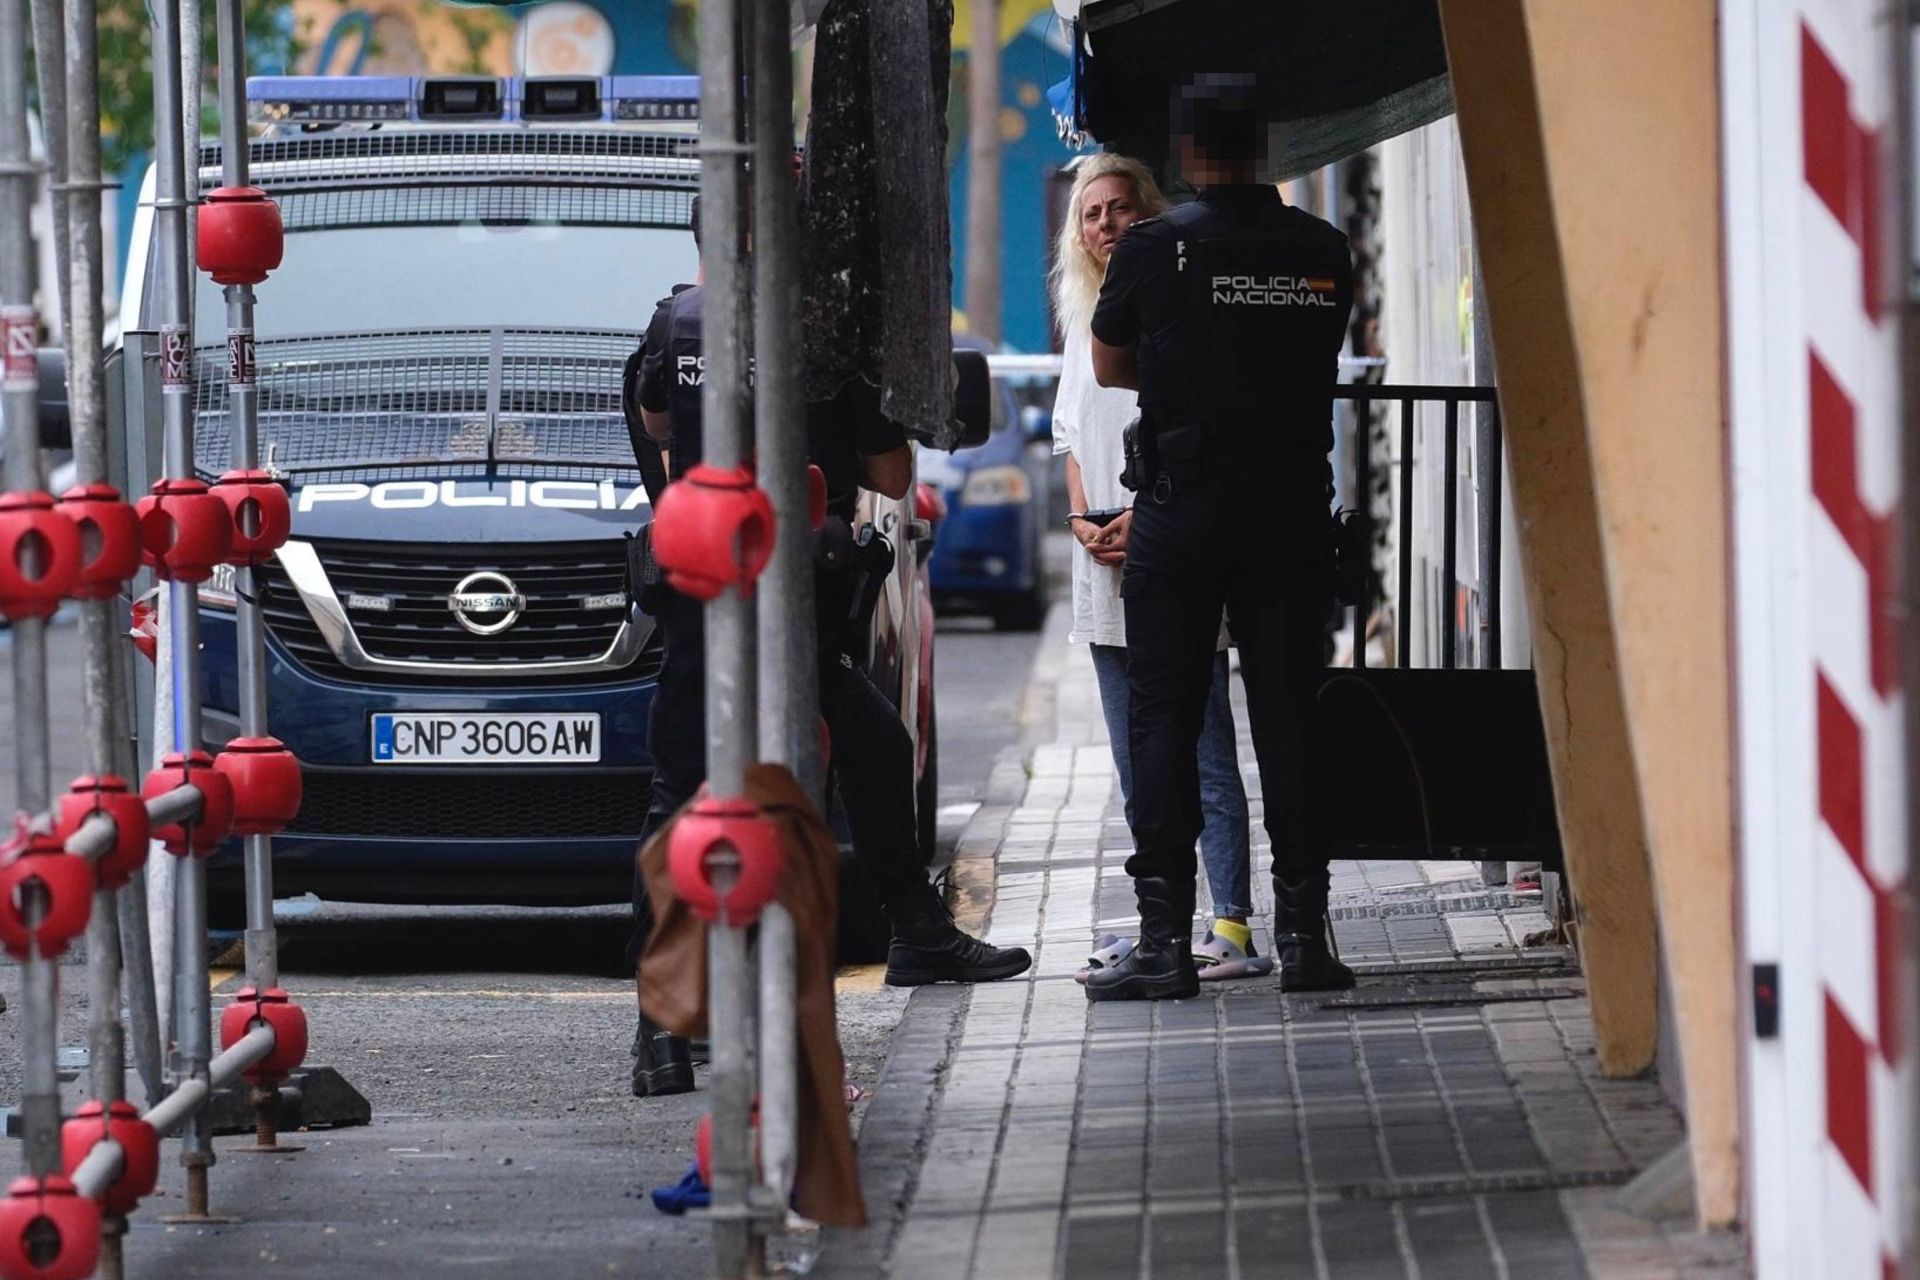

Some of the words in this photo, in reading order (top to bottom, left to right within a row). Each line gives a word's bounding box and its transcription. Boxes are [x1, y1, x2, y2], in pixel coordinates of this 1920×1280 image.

[1212, 276, 1311, 290] POLICIA
[1213, 291, 1337, 307] NACIONAL
[456, 596, 517, 608] NISSAN
[379, 743, 389, 754] E
